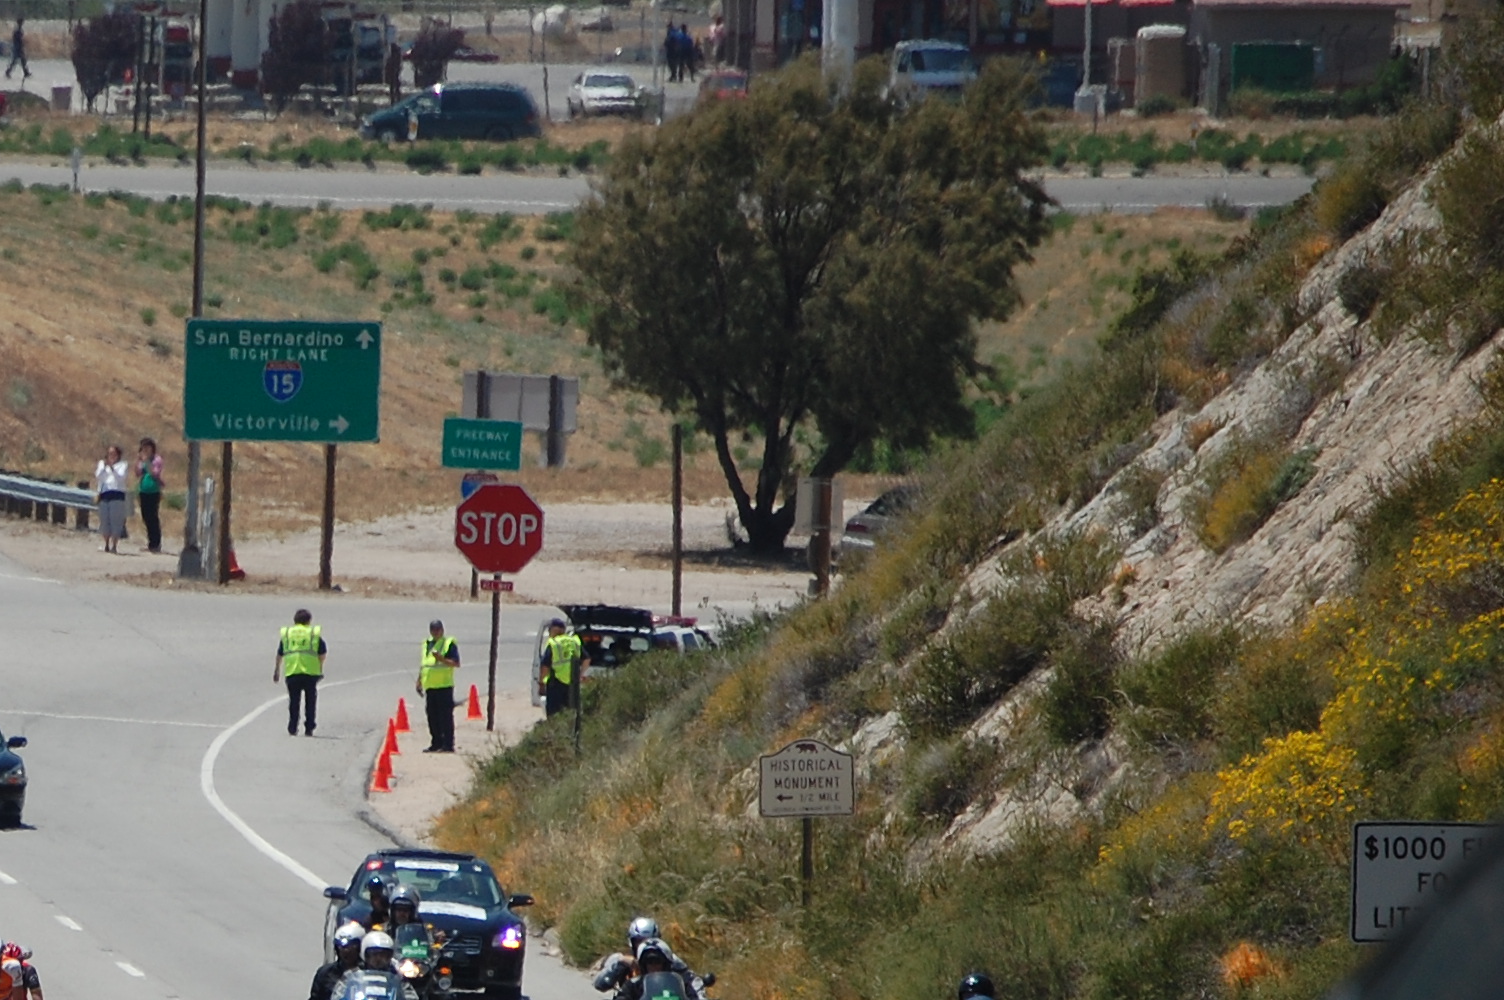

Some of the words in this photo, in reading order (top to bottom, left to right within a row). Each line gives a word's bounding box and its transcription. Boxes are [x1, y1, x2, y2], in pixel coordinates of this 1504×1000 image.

[195, 329, 229, 345] San
[239, 329, 344, 346] Bernardino
[230, 348, 278, 360] RIGHT
[286, 349, 328, 362] LANE
[272, 374, 294, 394] 15
[212, 413, 320, 431] Victorville
[456, 429, 509, 442] FREEWAY
[451, 448, 512, 461] ENTRANCE
[460, 511, 538, 546] STOP
[770, 759, 843, 772] HISTORICAL
[774, 776, 840, 789] MONUMENT
[800, 793, 814, 802] 1/2
[819, 792, 839, 801] MILE
[1364, 834, 1446, 861] $1000
